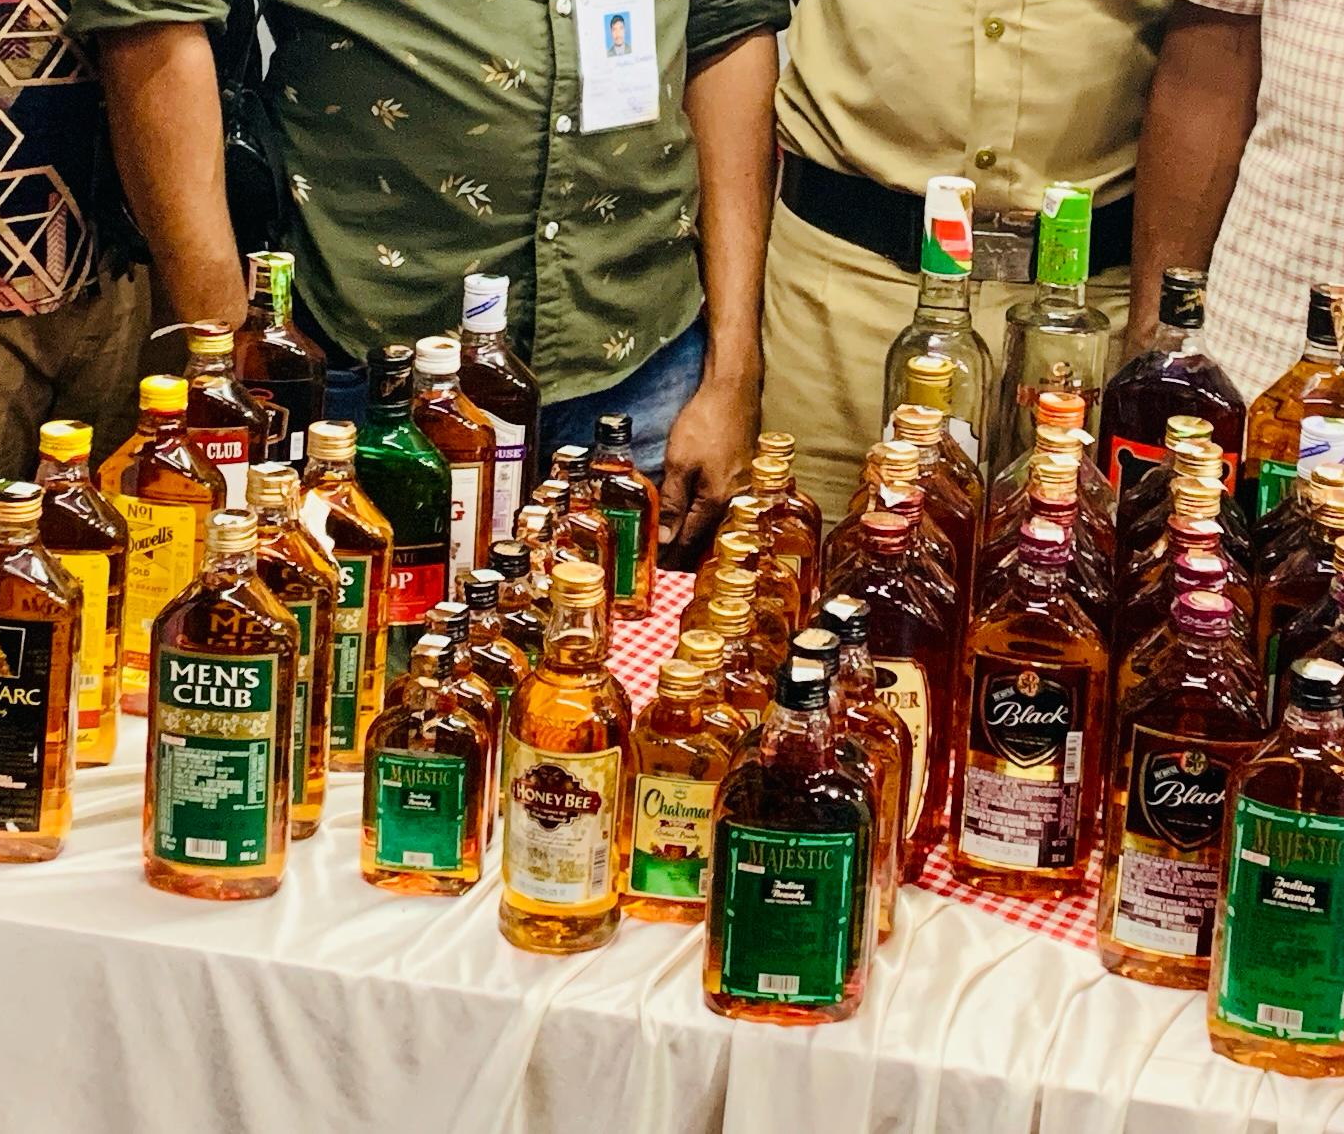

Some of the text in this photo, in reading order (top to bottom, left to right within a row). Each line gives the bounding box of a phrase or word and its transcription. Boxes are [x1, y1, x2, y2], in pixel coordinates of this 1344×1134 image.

[207, 442, 242, 459] CLUB
[170, 660, 260, 689] MEN'S
[173, 684, 252, 709] CLUB
[987, 701, 1069, 727] Black
[390, 765, 452, 787] MAJESTIC
[516, 783, 593, 810] HONEY BEE
[749, 842, 834, 875] MAJESTIC
[1272, 887, 1316, 906] Brandy
[1275, 876, 1316, 894] Indian
